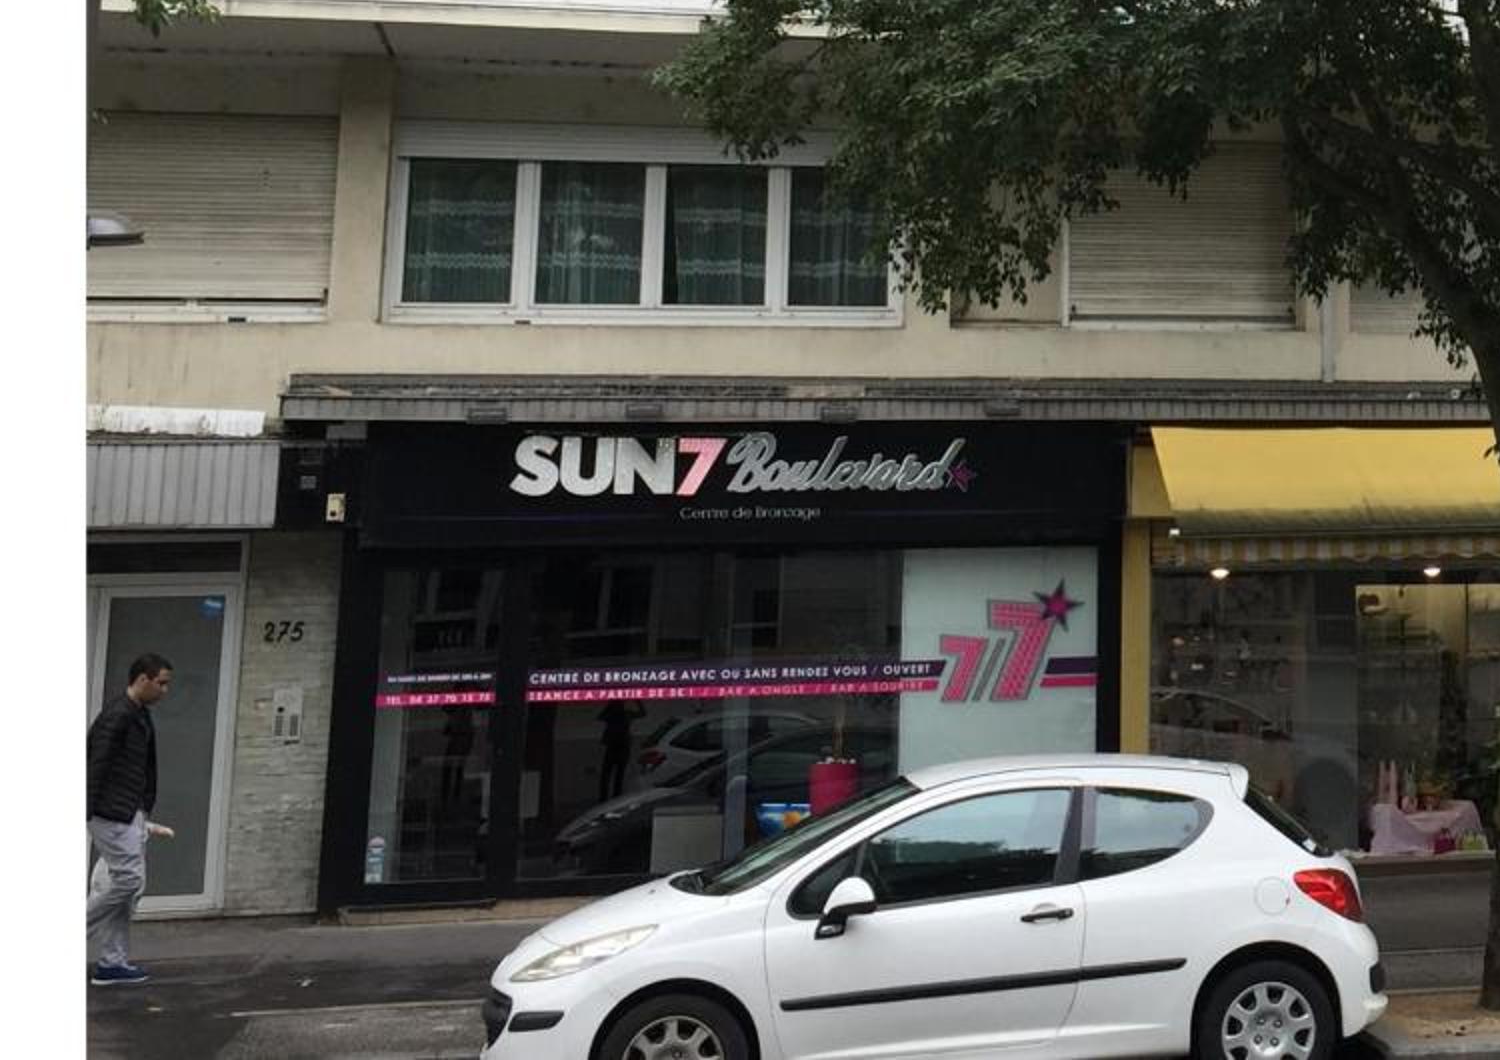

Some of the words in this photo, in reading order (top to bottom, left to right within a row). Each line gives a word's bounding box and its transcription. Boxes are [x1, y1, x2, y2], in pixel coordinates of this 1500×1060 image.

[726, 431, 966, 493] Boulevard
[679, 506, 729, 520] Centre
[732, 505, 752, 519] de
[755, 505, 821, 521] Bronzage
[264, 621, 305, 643] 275
[529, 672, 579, 685] CENTRE
[583, 671, 600, 684] DE
[604, 670, 676, 683] BRONZAGE
[681, 668, 716, 681] AVEC
[720, 668, 740, 680] OU
[744, 667, 778, 679] SANS
[781, 666, 829, 678] RENDEZ
[833, 665, 867, 677] VOUS
[883, 663, 931, 676] OUVERT
[528, 690, 579, 702] SEANCE
[584, 690, 594, 701] A
[600, 688, 643, 700] PARTIR
[648, 687, 664, 699] DE
